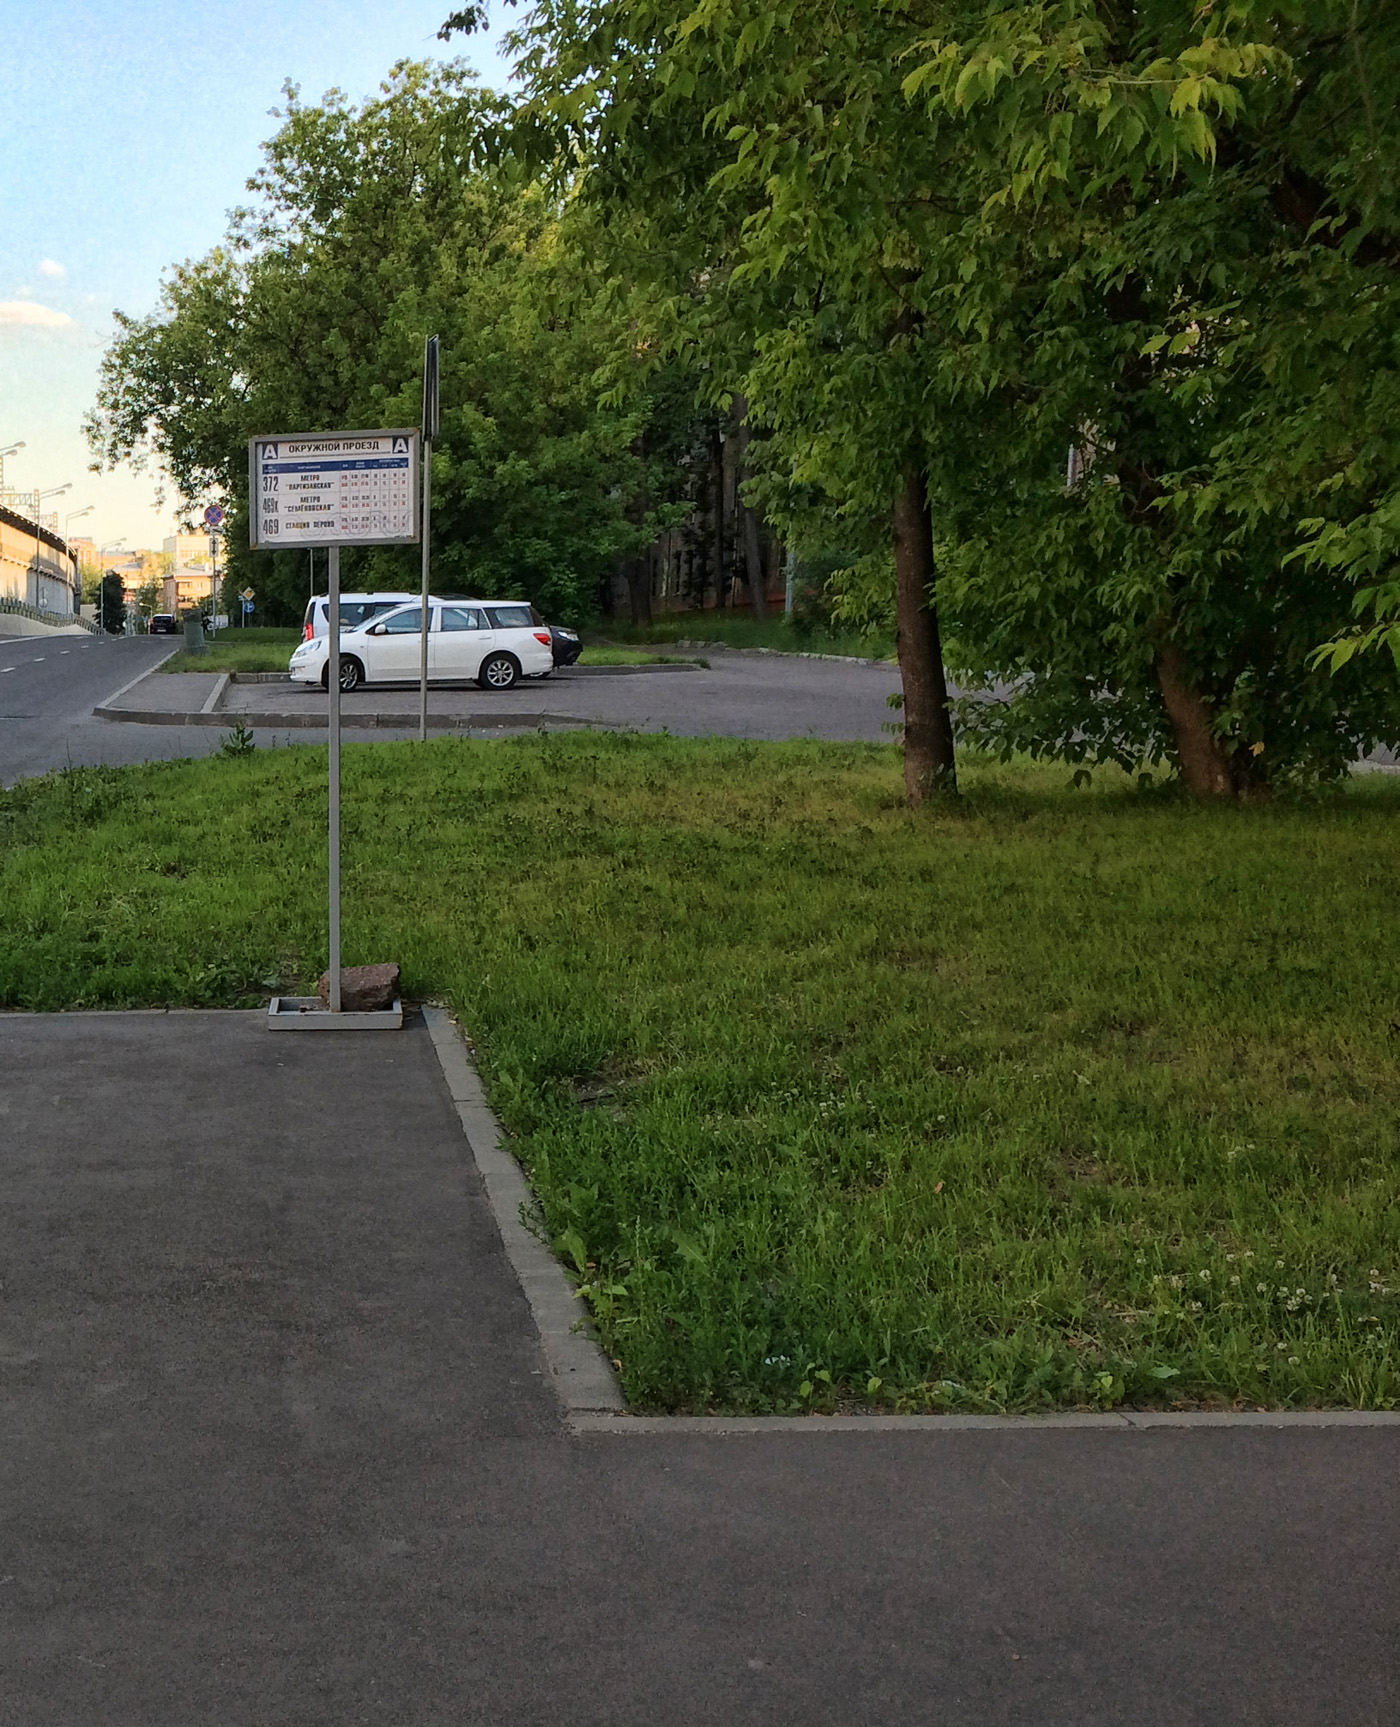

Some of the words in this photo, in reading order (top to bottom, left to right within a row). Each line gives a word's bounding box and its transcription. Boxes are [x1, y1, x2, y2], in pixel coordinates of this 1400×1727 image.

[288, 442, 341, 453] ОКРУЖНОЙ
[342, 440, 380, 451] ПРОЕЗД
[262, 476, 279, 492] 372
[262, 519, 279, 535] 469
[285, 521, 310, 530] СТАНЦИЯ
[313, 520, 335, 528] ПЕРОВО
